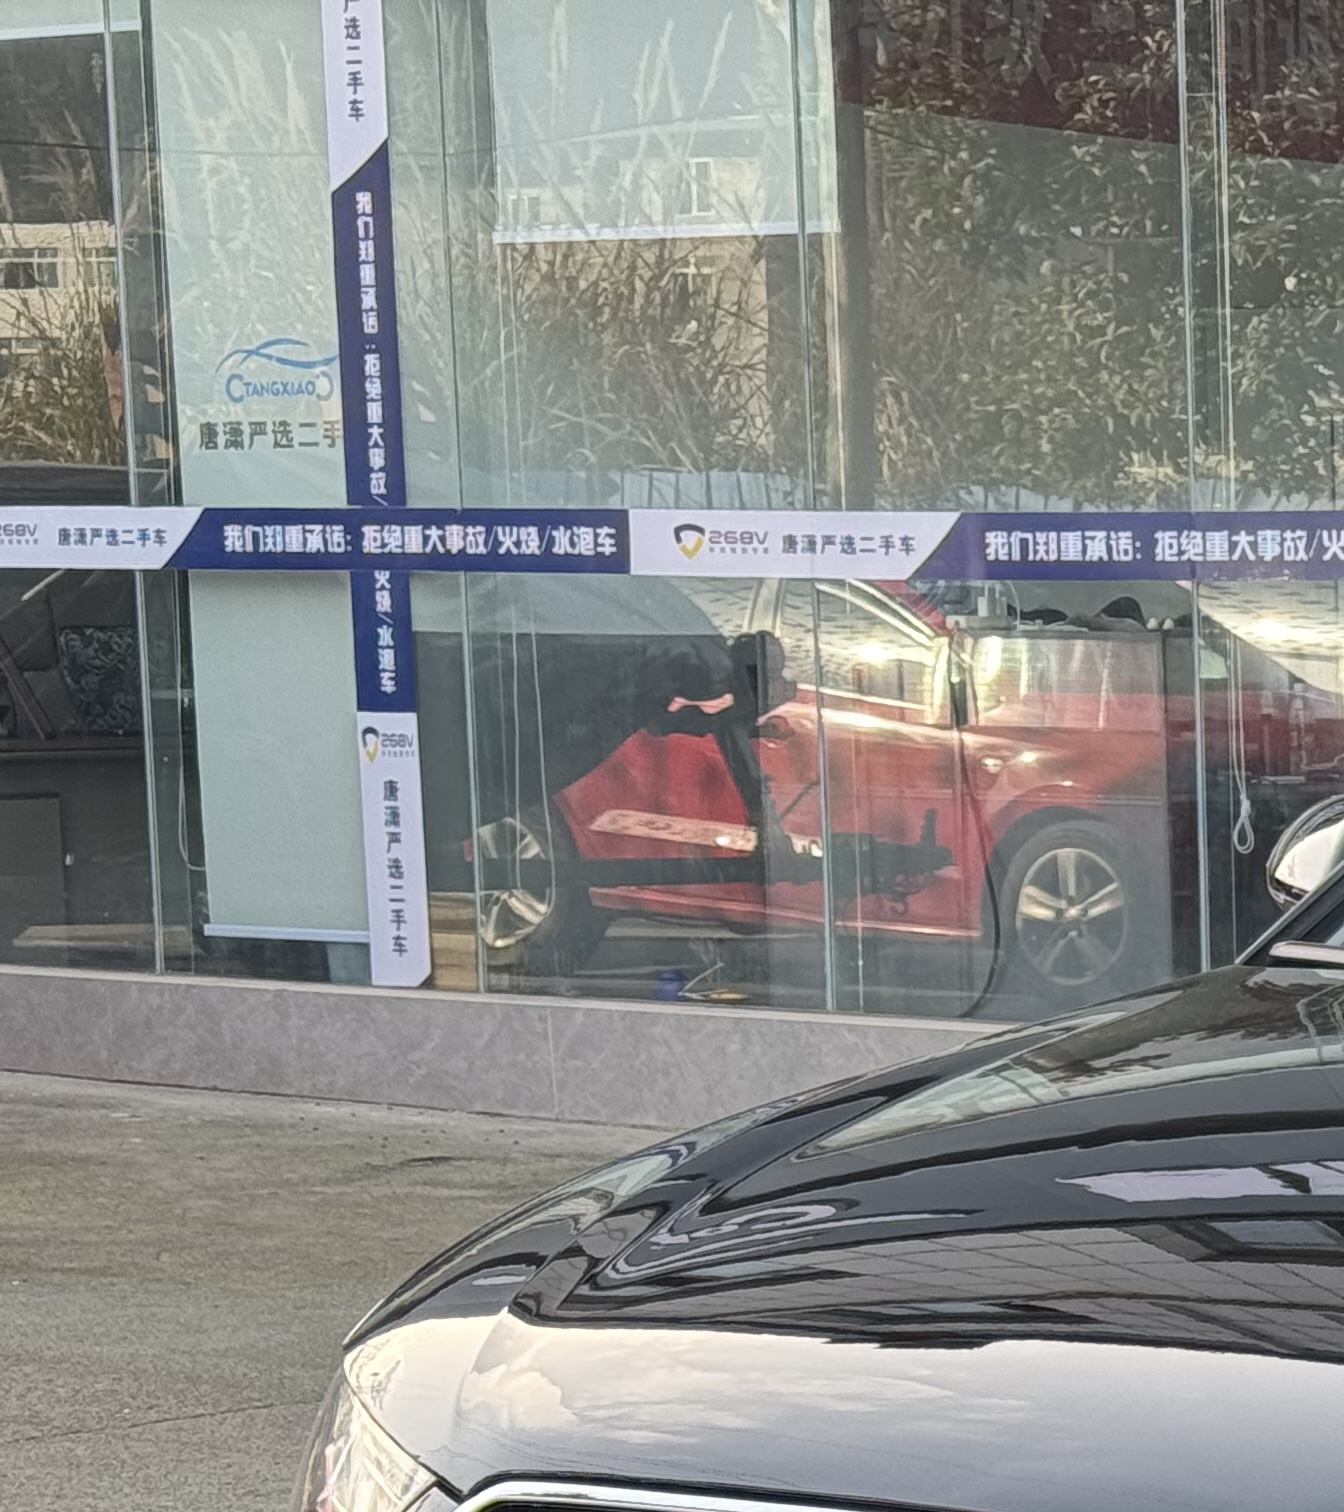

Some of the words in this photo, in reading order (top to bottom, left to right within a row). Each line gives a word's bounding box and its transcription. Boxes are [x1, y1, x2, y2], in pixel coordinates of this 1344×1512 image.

[199, 419, 341, 450] 唐潇严选二手
[0, 523, 38, 539] 68V
[57, 527, 169, 548] 唐潇严选二手车
[707, 530, 770, 546] 268V
[781, 534, 917, 557] 唐潇严选二手车
[383, 779, 408, 958] 唐潇严选二手车
